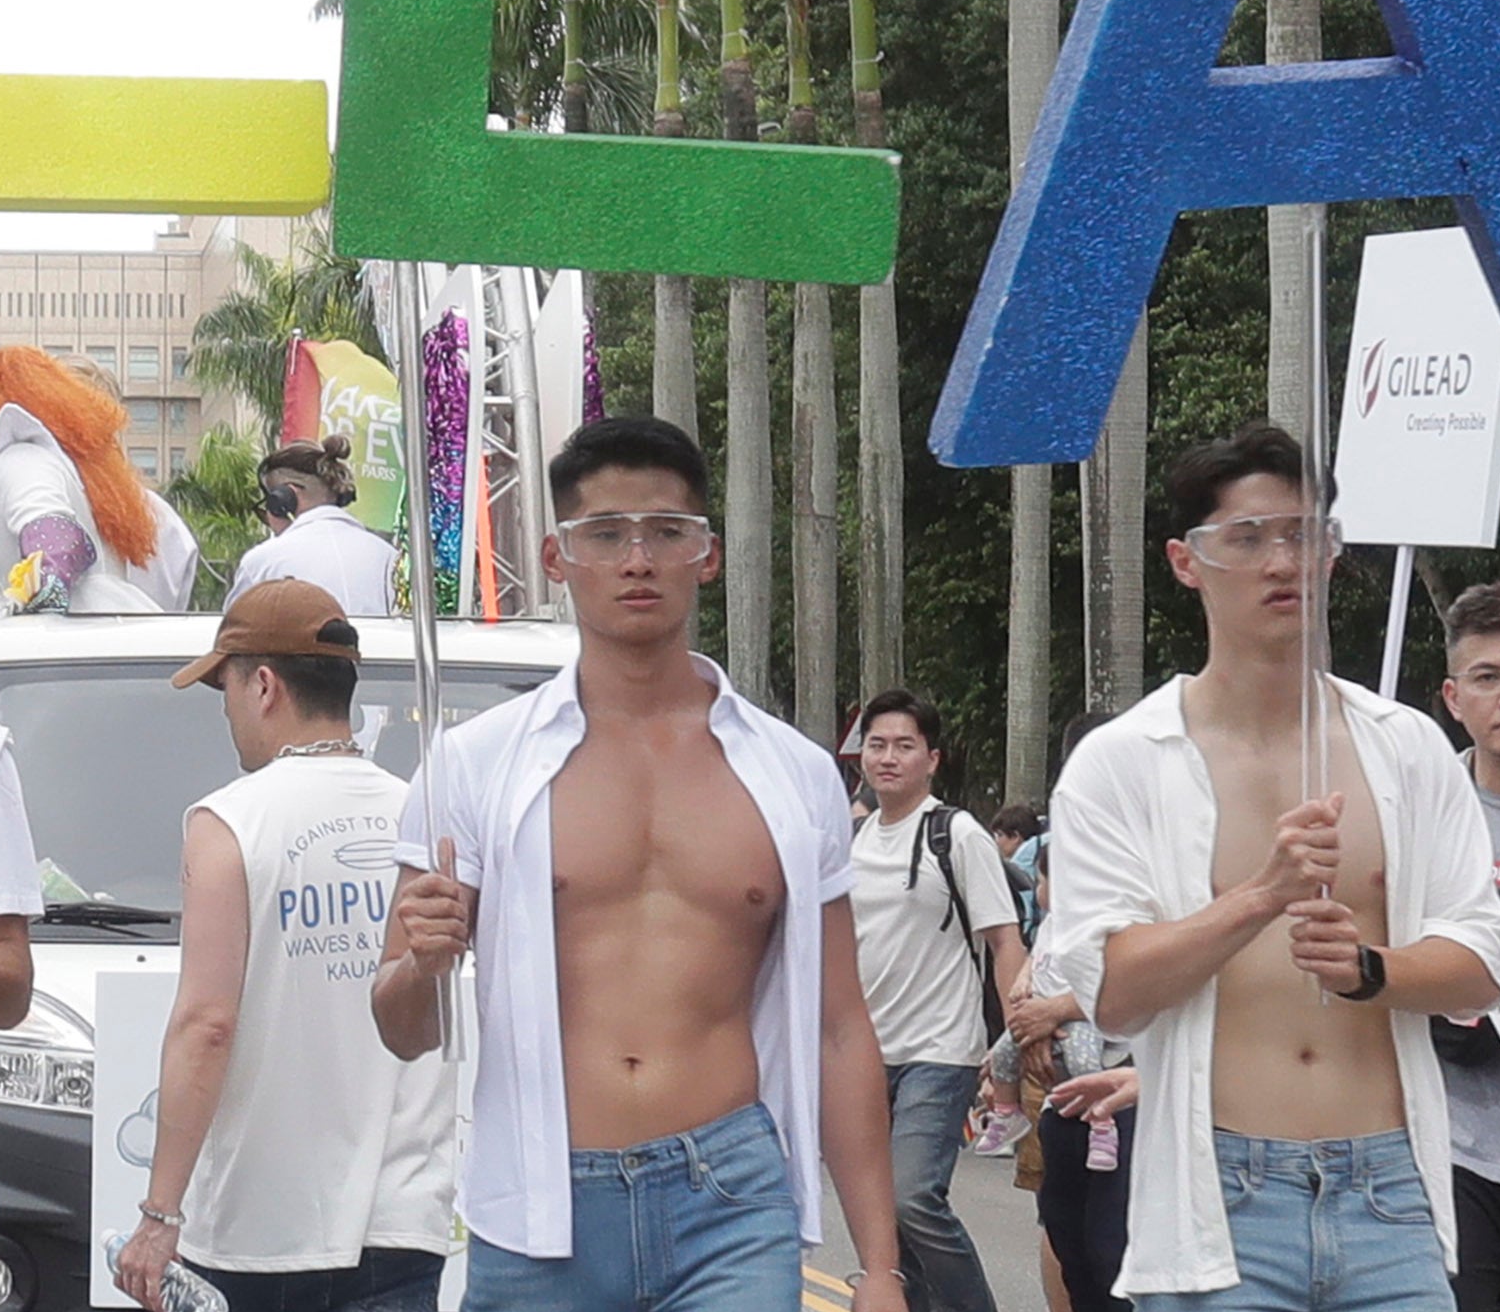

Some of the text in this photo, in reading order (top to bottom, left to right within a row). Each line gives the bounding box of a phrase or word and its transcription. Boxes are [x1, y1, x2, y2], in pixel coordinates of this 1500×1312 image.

[1387, 352, 1473, 397] GILEAD
[1407, 411, 1487, 437] Creating Possible
[361, 464, 397, 481] PARIS
[285, 816, 389, 865] AGAINST TO
[278, 880, 386, 931] POIPU
[285, 932, 351, 959] WAVES
[355, 932, 370, 951] &
[326, 960, 378, 982] KAUA
